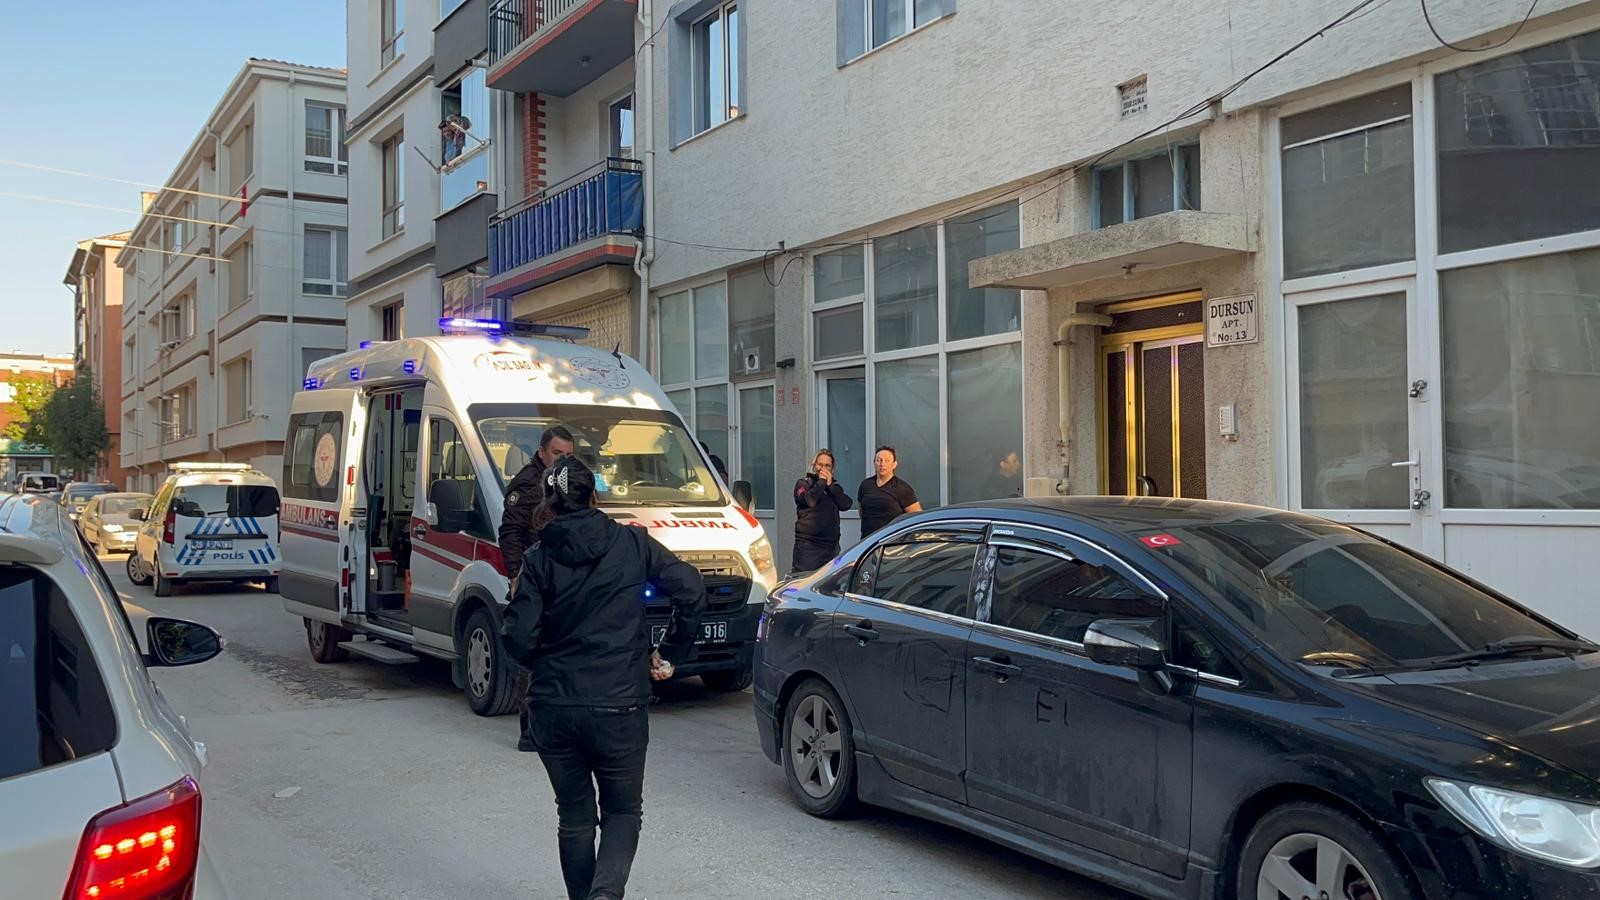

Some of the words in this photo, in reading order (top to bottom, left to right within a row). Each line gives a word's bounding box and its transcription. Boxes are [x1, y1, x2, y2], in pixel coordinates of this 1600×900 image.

[1210, 300, 1253, 318] DURSUN
[1221, 319, 1243, 329] APT.
[1218, 333, 1233, 342] No:
[1235, 330, 1247, 340] 13
[280, 503, 326, 528] AMBULANS
[704, 624, 725, 639] 916
